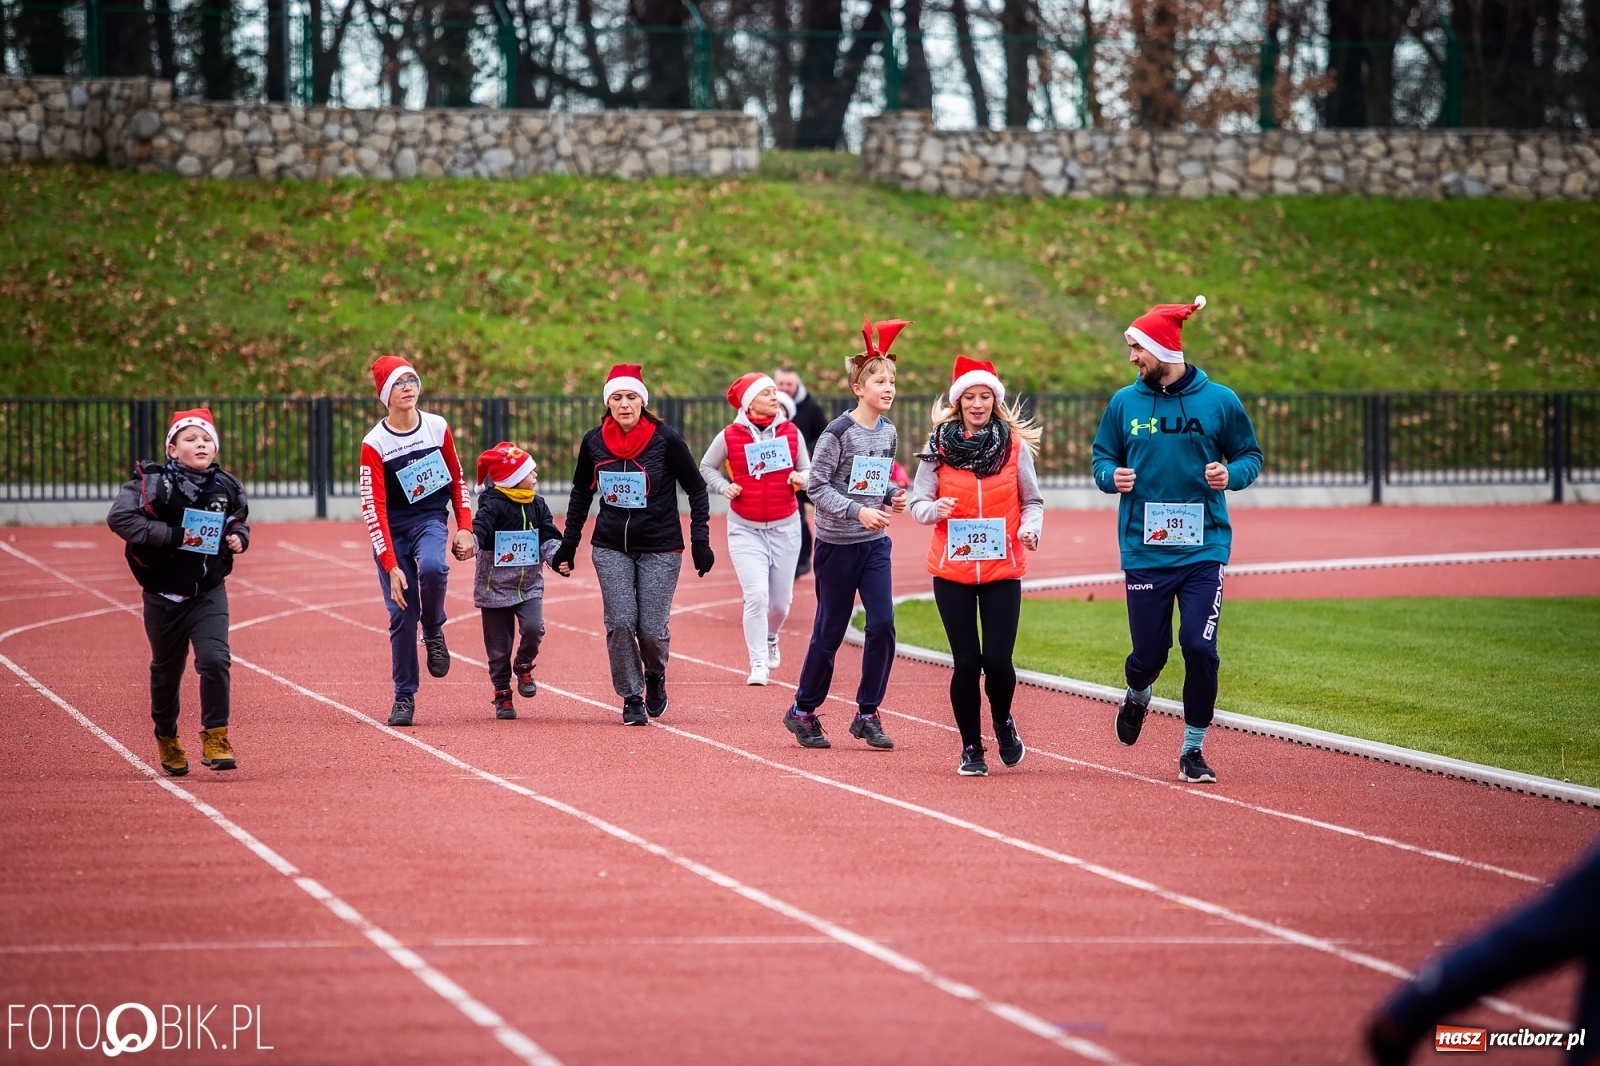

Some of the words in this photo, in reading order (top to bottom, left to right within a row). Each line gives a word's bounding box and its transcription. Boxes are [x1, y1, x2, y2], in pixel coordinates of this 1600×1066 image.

[1160, 417, 1205, 436] UA
[760, 450, 777, 460] 055
[416, 468, 433, 483] 027
[866, 470, 881, 480] 035
[613, 484, 631, 494] 033
[1166, 518, 1184, 529] 131
[200, 526, 219, 538] 025
[967, 533, 987, 544] 123
[512, 543, 528, 552] 017
[1202, 563, 1225, 641] GIVOVA
